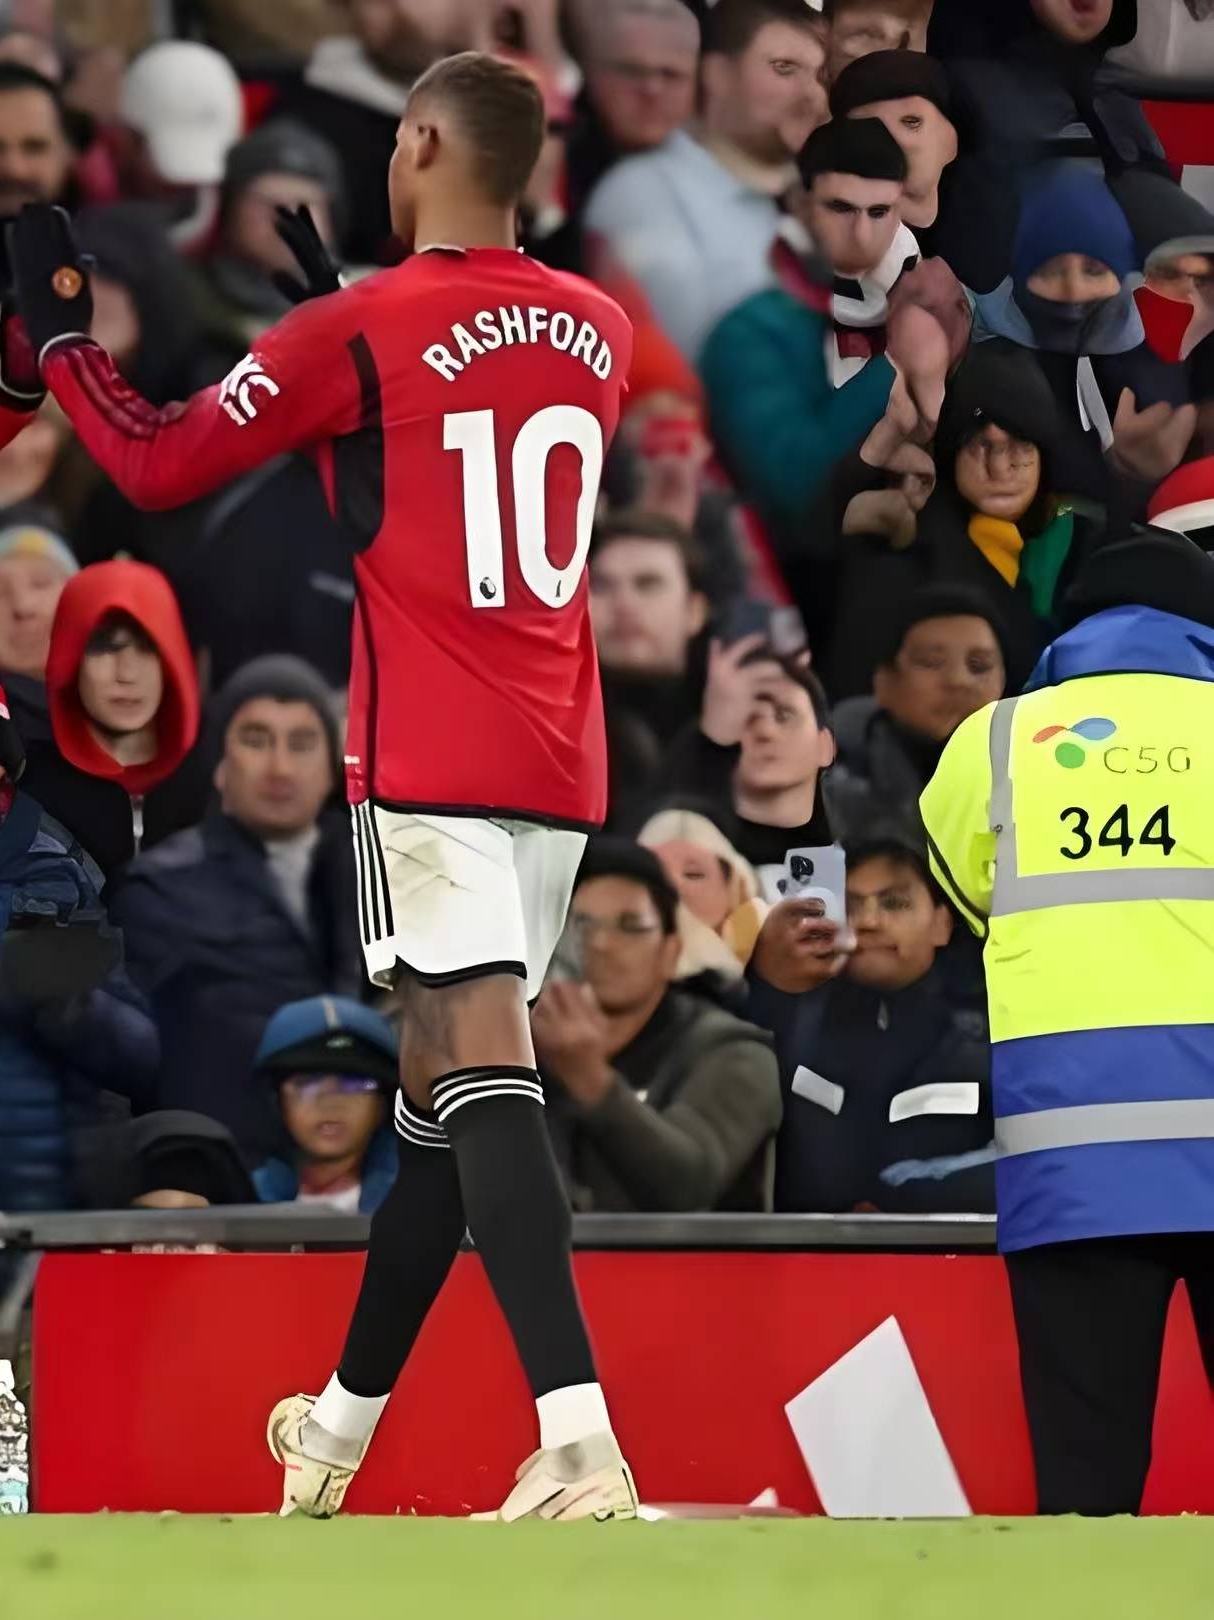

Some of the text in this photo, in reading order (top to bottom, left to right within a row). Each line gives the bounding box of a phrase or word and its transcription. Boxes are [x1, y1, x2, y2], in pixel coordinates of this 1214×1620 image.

[421, 304, 612, 382] RASHFORD
[442, 404, 603, 609] 10
[1059, 803, 1177, 860] 344
